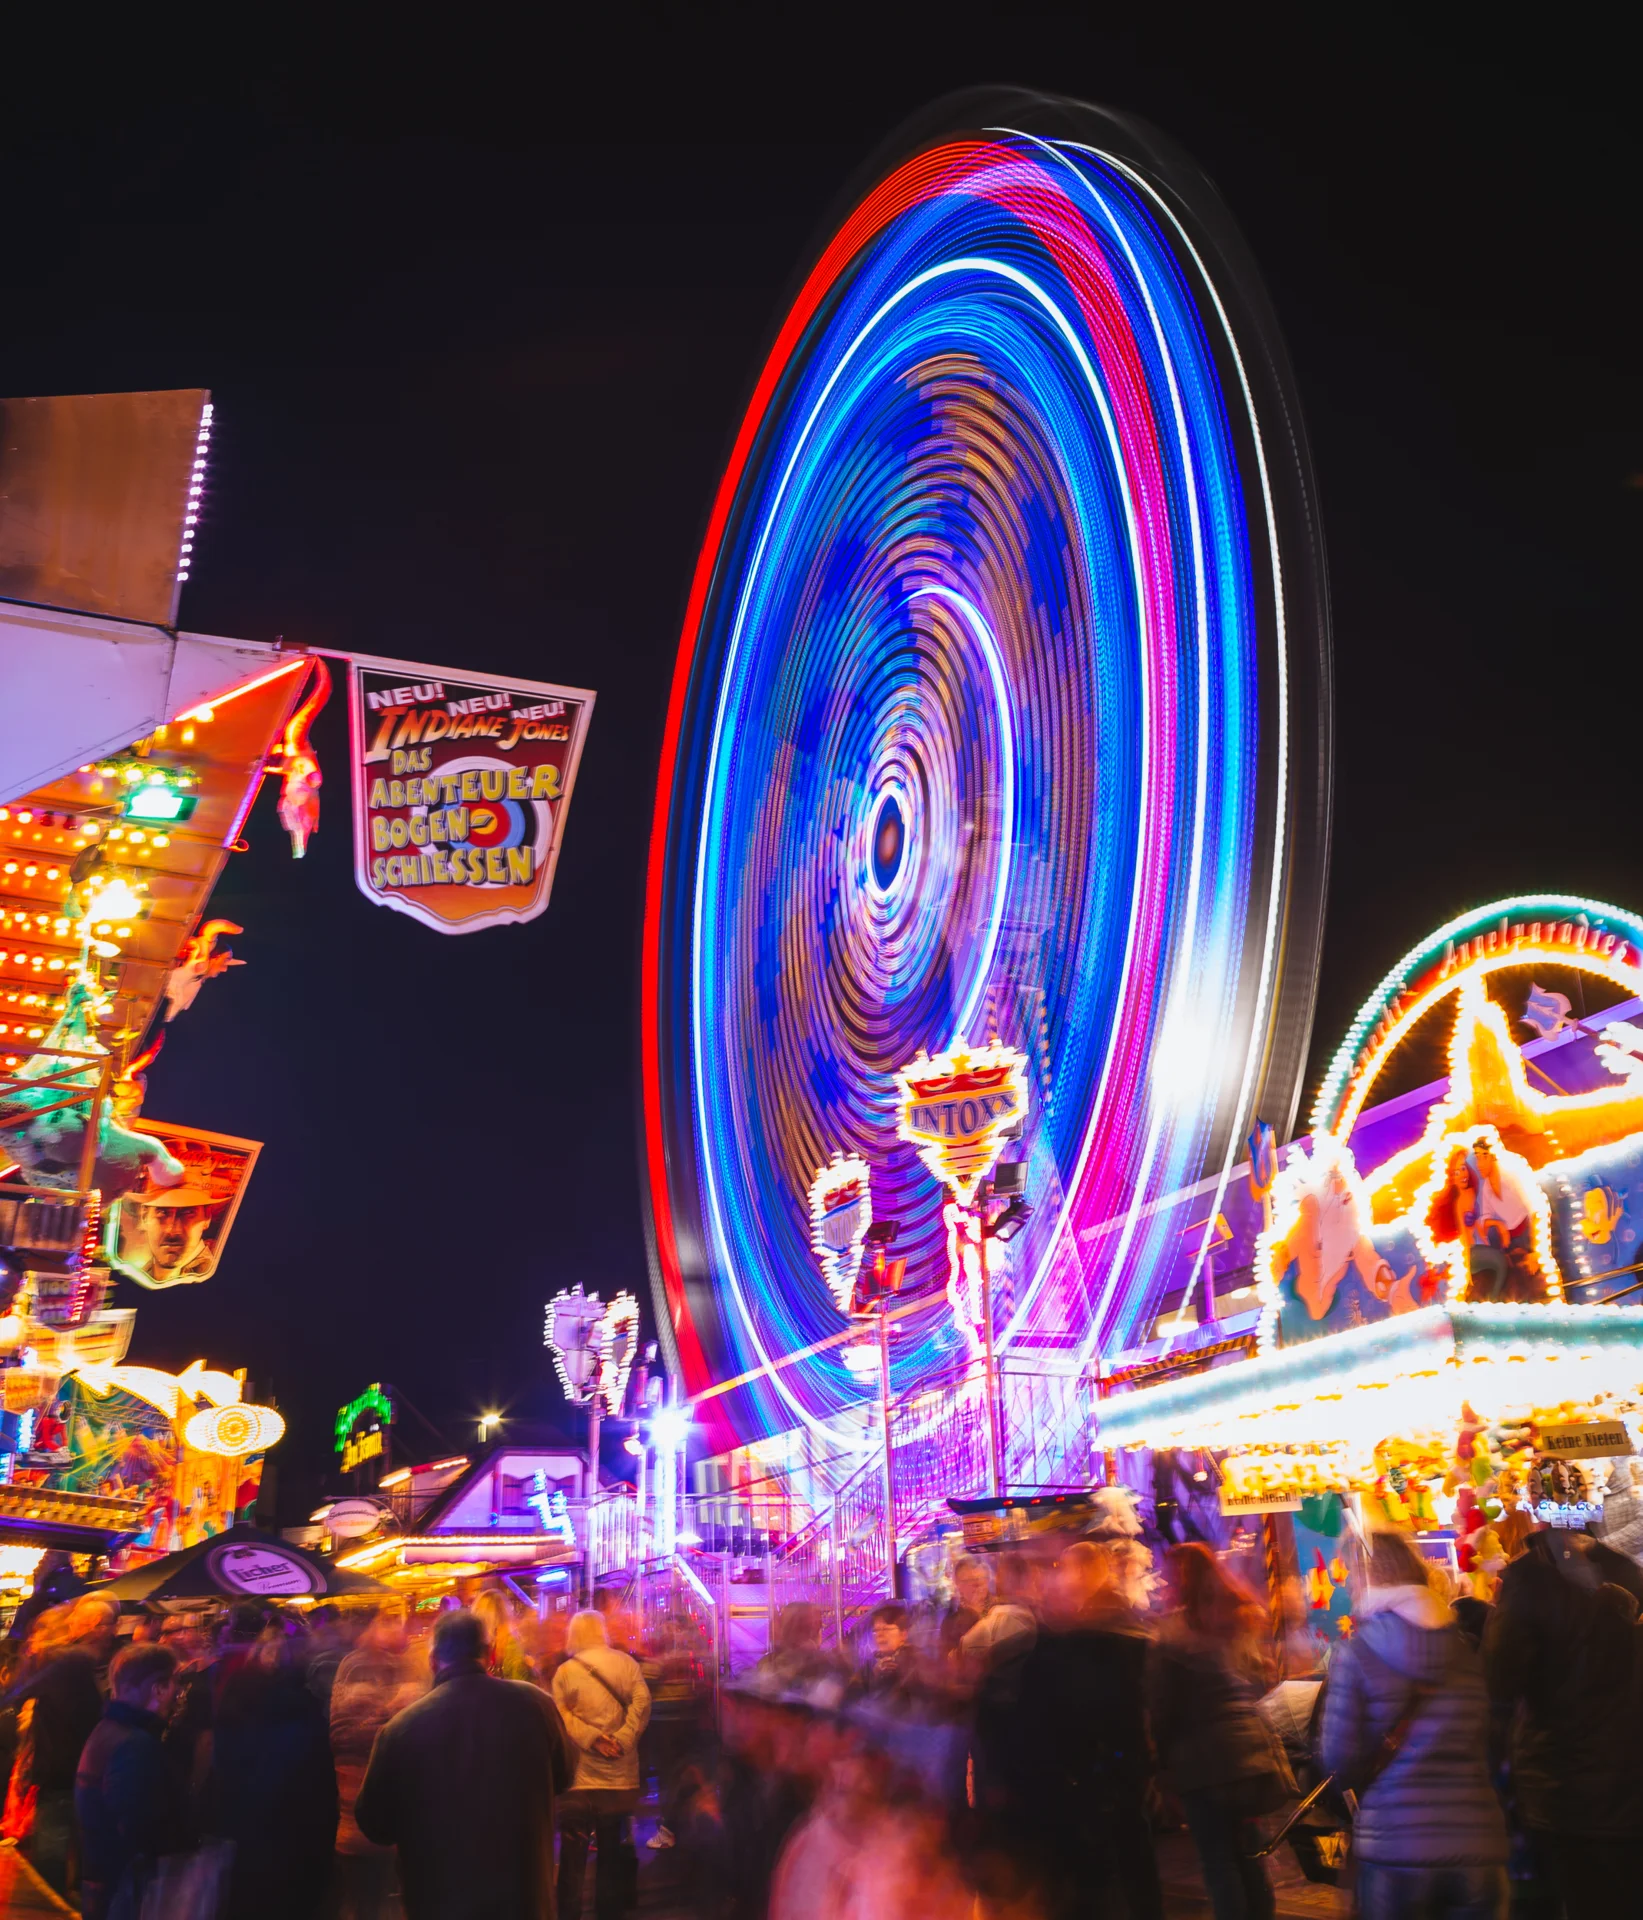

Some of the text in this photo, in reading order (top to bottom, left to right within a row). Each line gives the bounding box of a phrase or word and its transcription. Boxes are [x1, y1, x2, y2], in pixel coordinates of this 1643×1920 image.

[366, 682, 565, 720] NEU! NEU! NEU!
[364, 706, 569, 764] INDIANE JONES
[391, 747, 431, 775] DAS
[370, 764, 563, 809] ABENTEUER
[372, 846, 535, 889] SCHIESSEN
[910, 1090, 1016, 1138] INTOXX
[1544, 1435, 1582, 1450] Keine
